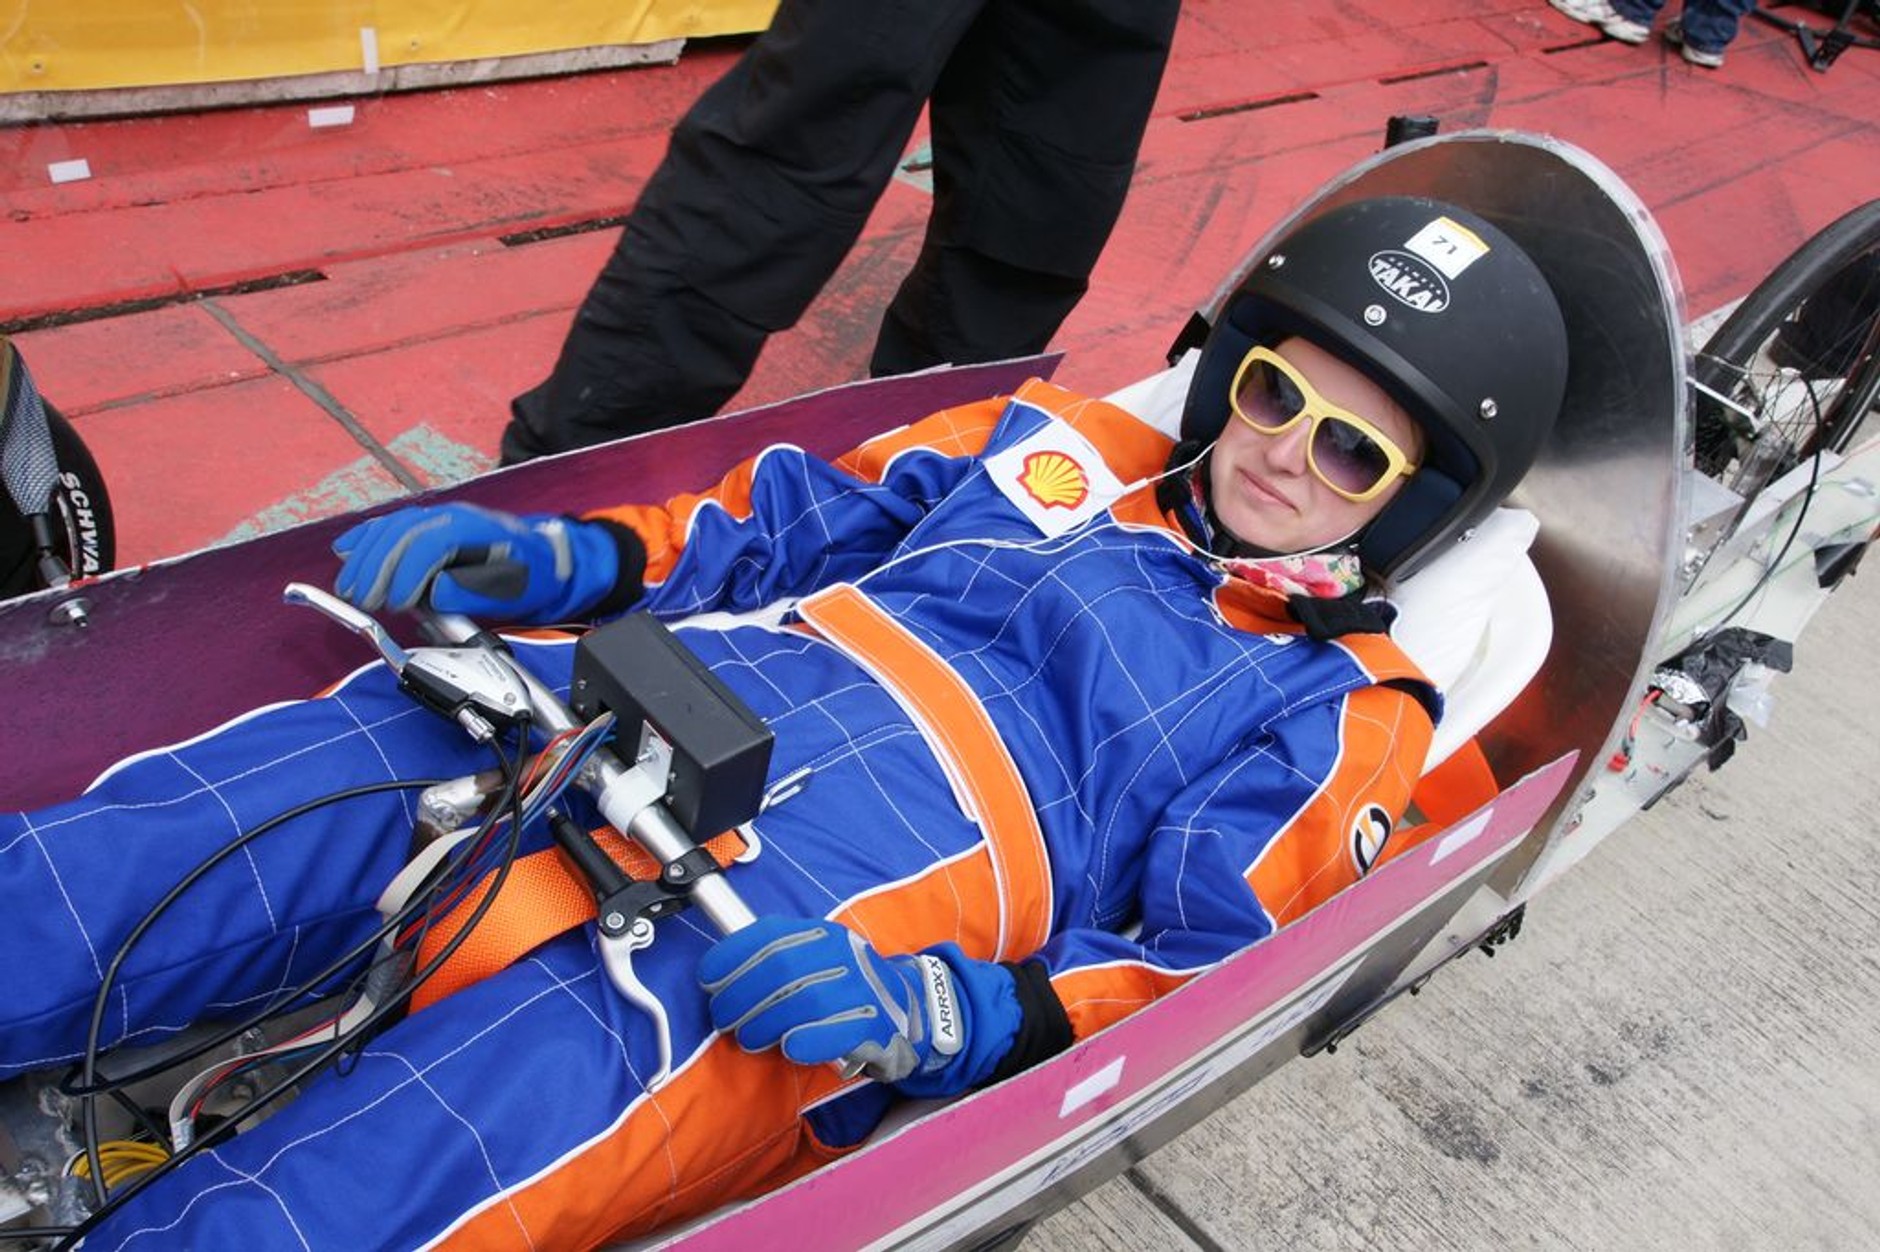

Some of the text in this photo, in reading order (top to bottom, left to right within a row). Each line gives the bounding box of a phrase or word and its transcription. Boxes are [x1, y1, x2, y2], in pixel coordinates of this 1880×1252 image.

[1432, 235, 1458, 255] 71
[59, 471, 100, 577] SCHWA
[928, 958, 954, 1038] ARROXX
